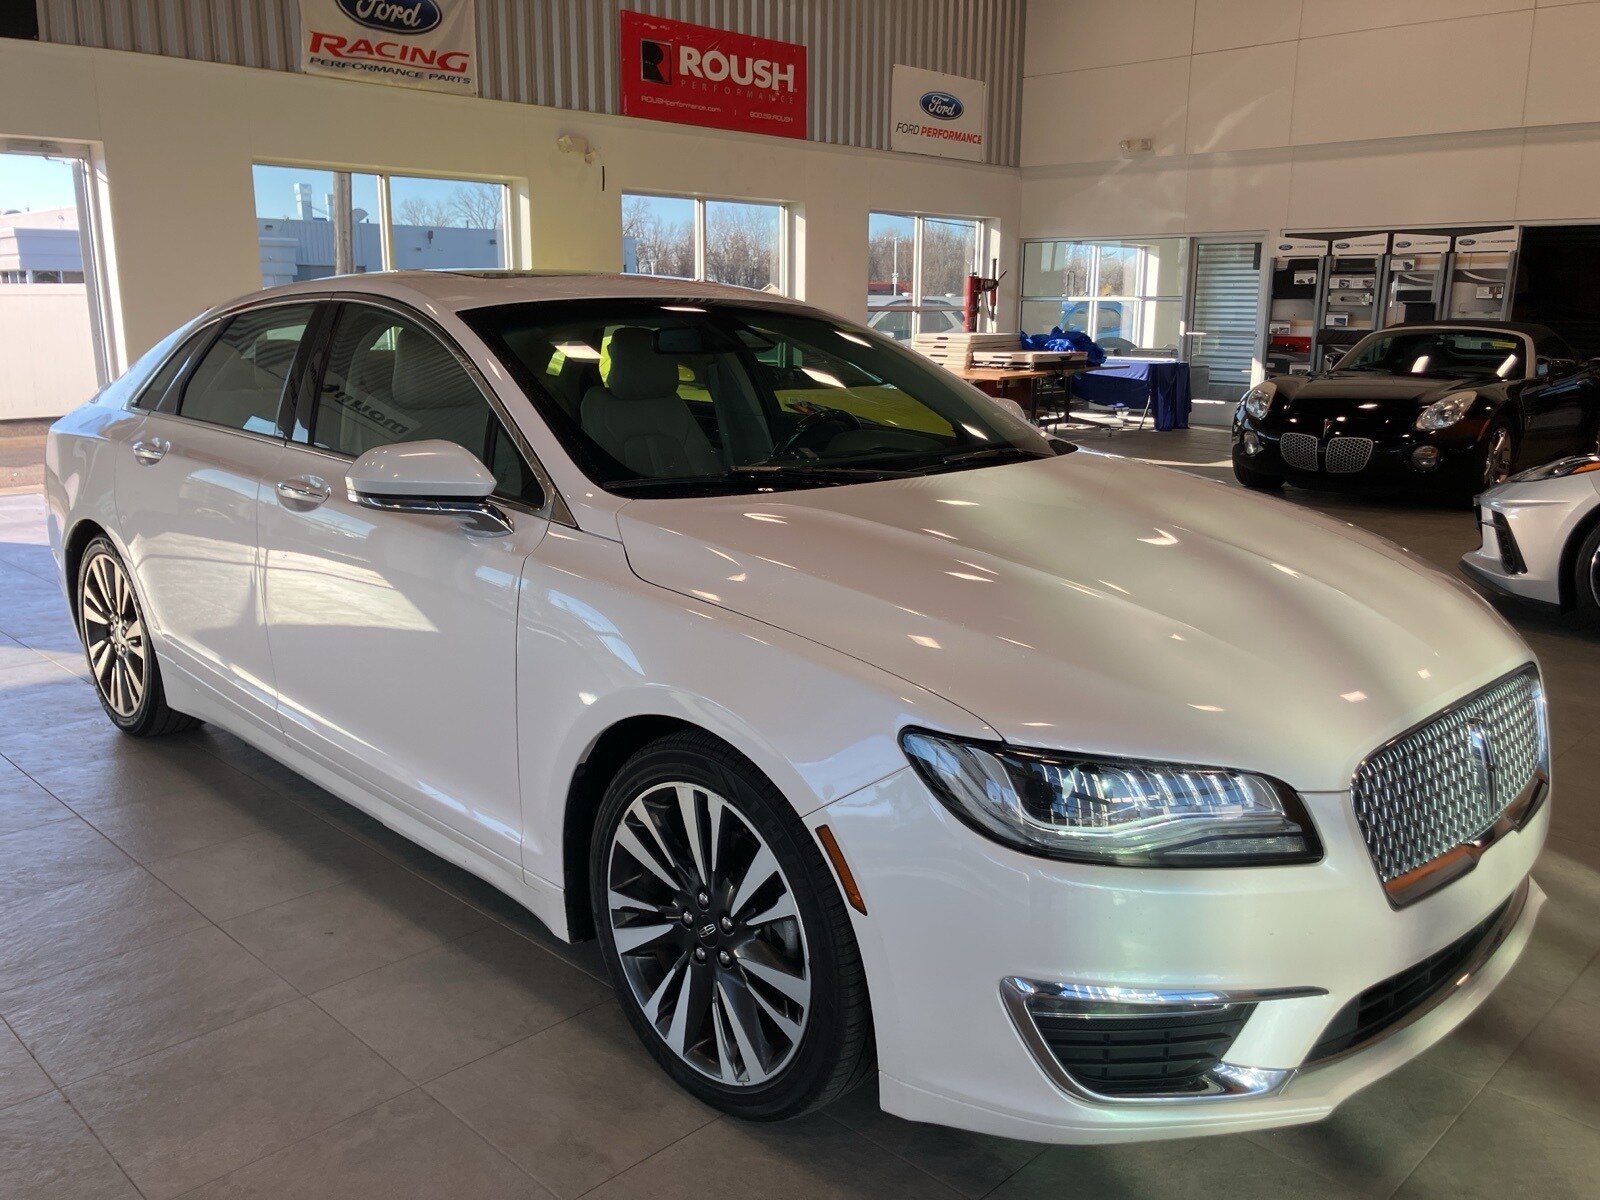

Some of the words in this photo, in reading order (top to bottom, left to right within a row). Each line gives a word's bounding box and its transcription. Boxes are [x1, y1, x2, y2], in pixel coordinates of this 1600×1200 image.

[309, 30, 470, 73] RACING
[309, 57, 424, 79] PERFORMANCE
[428, 73, 471, 84] PARTS
[678, 45, 795, 93] ROUSH
[680, 79, 794, 105] PERFORMANCE
[928, 95, 956, 116] Ford
[896, 122, 920, 136] FORD
[920, 126, 982, 145] PERFORMANCE
